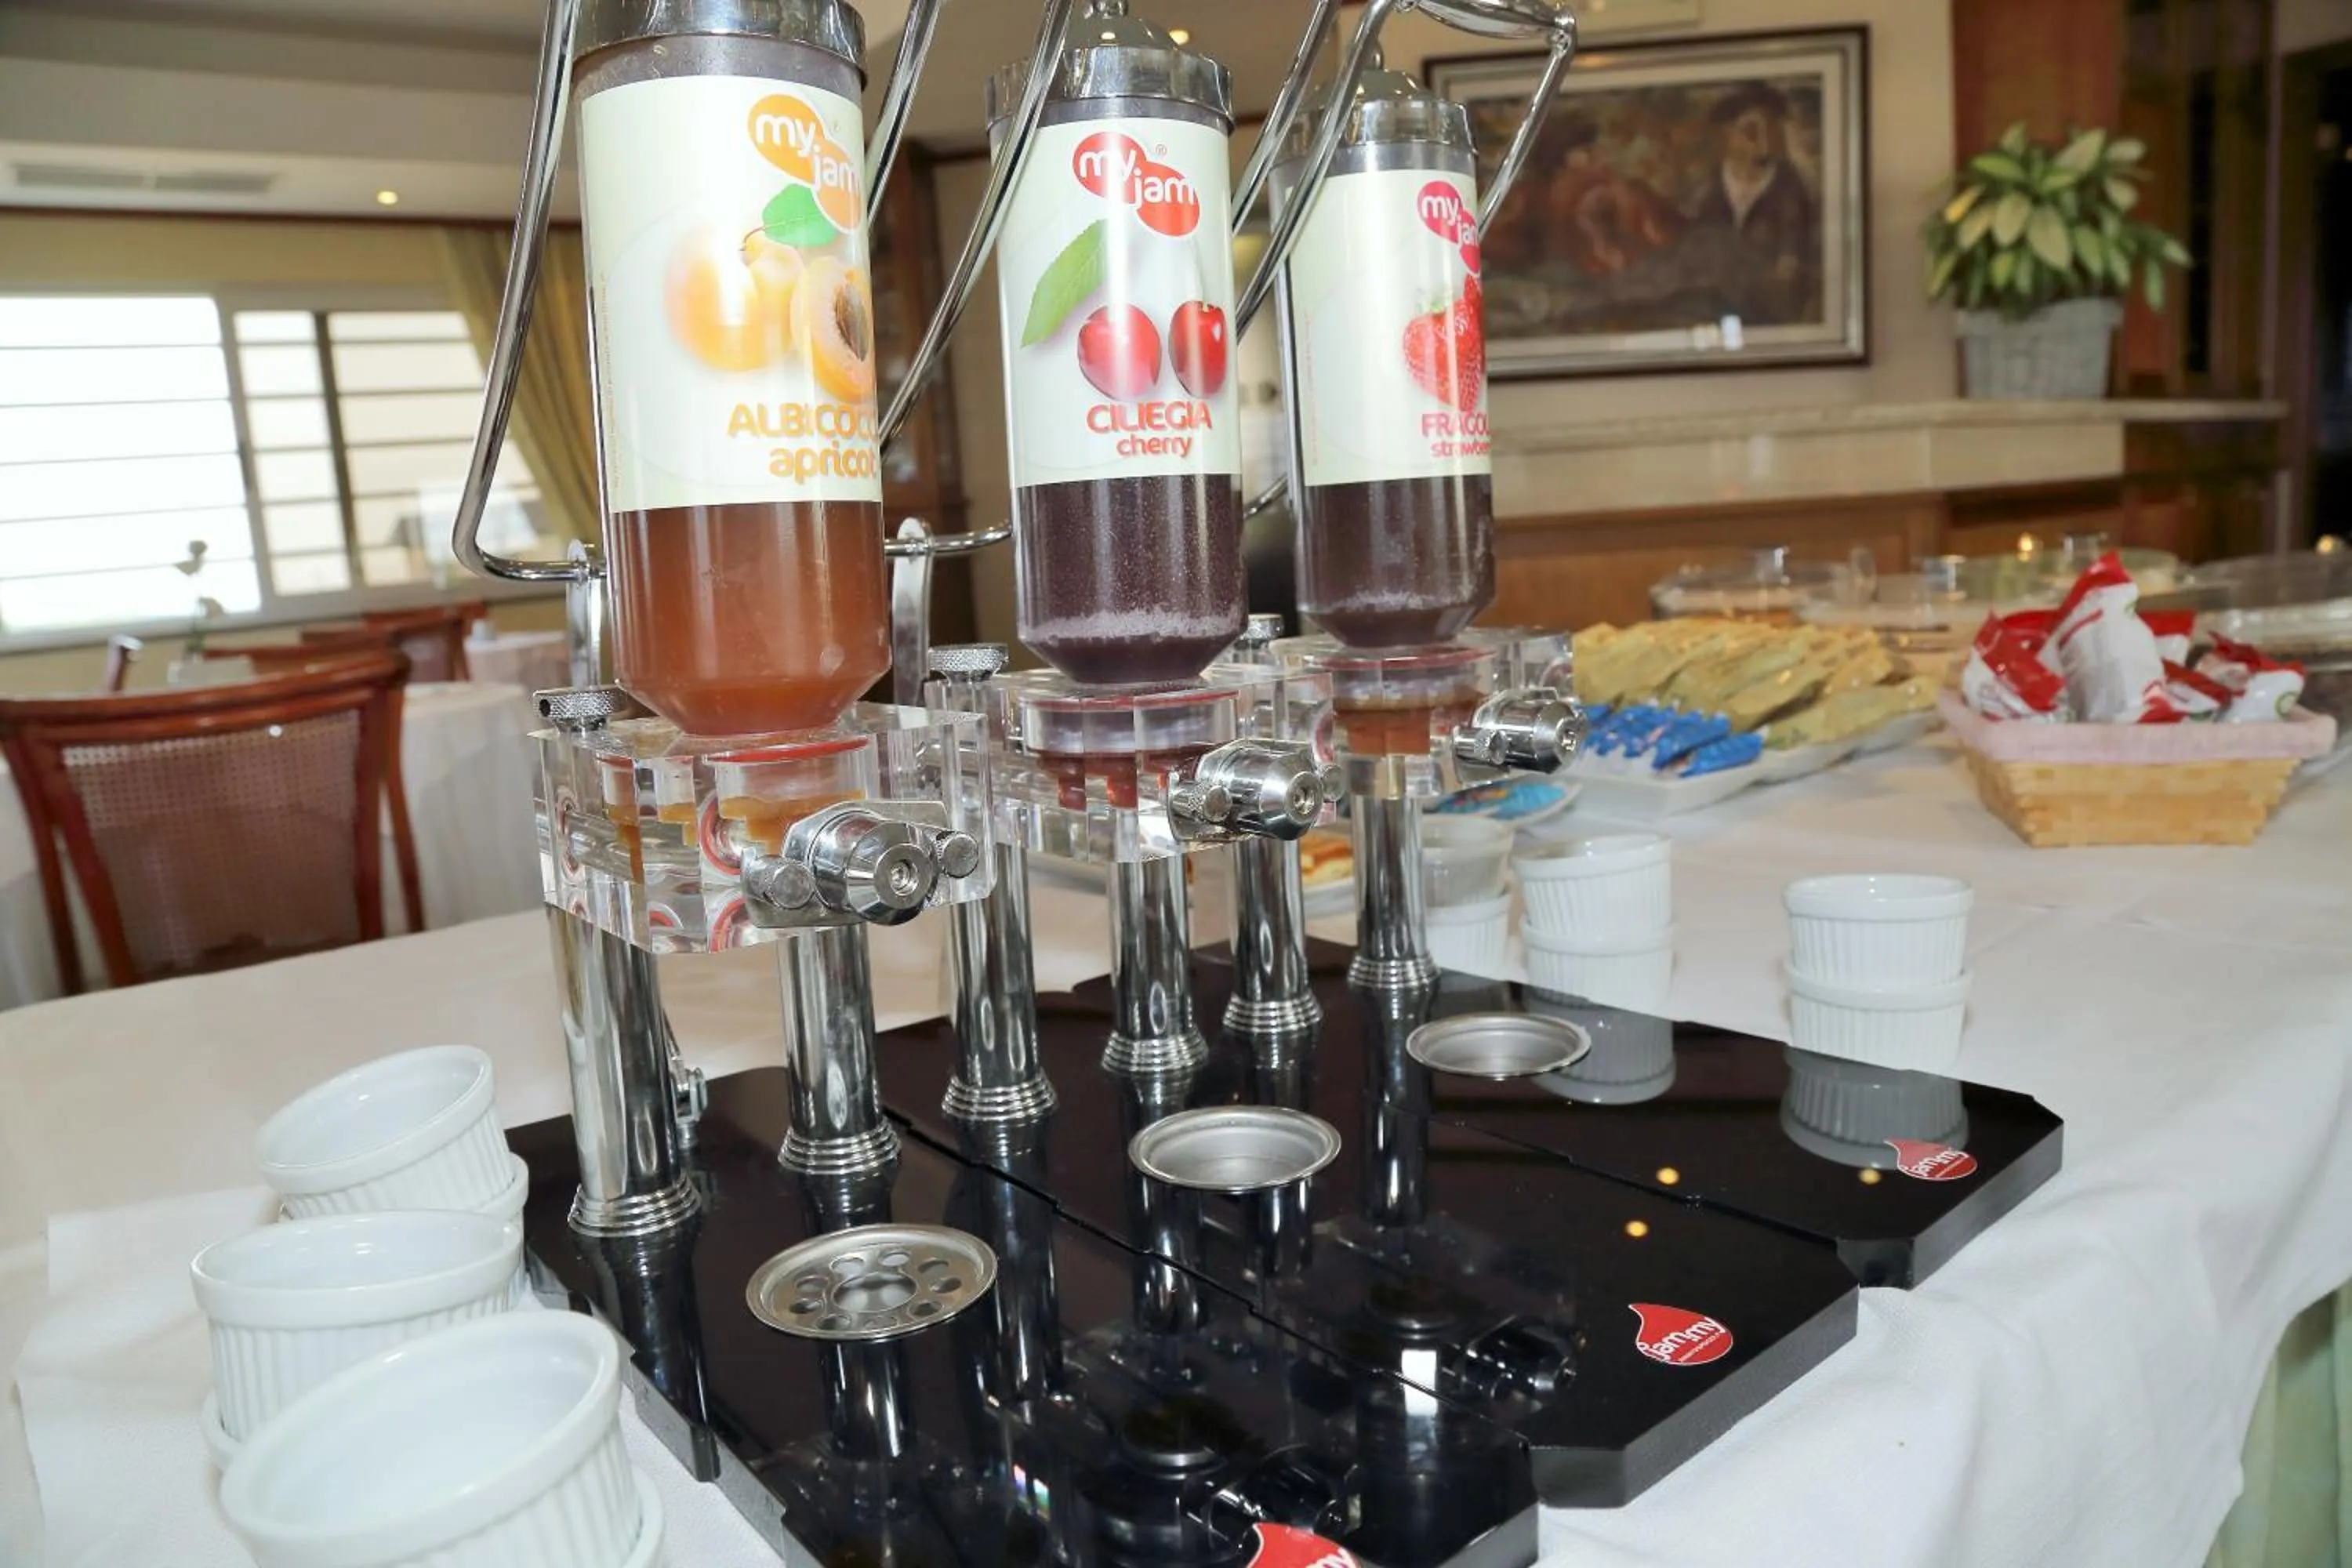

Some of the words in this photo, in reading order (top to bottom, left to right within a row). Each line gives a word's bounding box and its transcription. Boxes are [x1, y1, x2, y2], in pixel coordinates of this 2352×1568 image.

[755, 114, 816, 158] my
[1080, 148, 1136, 185] my
[1133, 167, 1195, 209] jam
[1421, 195, 1458, 227] my
[1086, 401, 1213, 434] CILIEGIA
[1116, 434, 1192, 458] cherry
